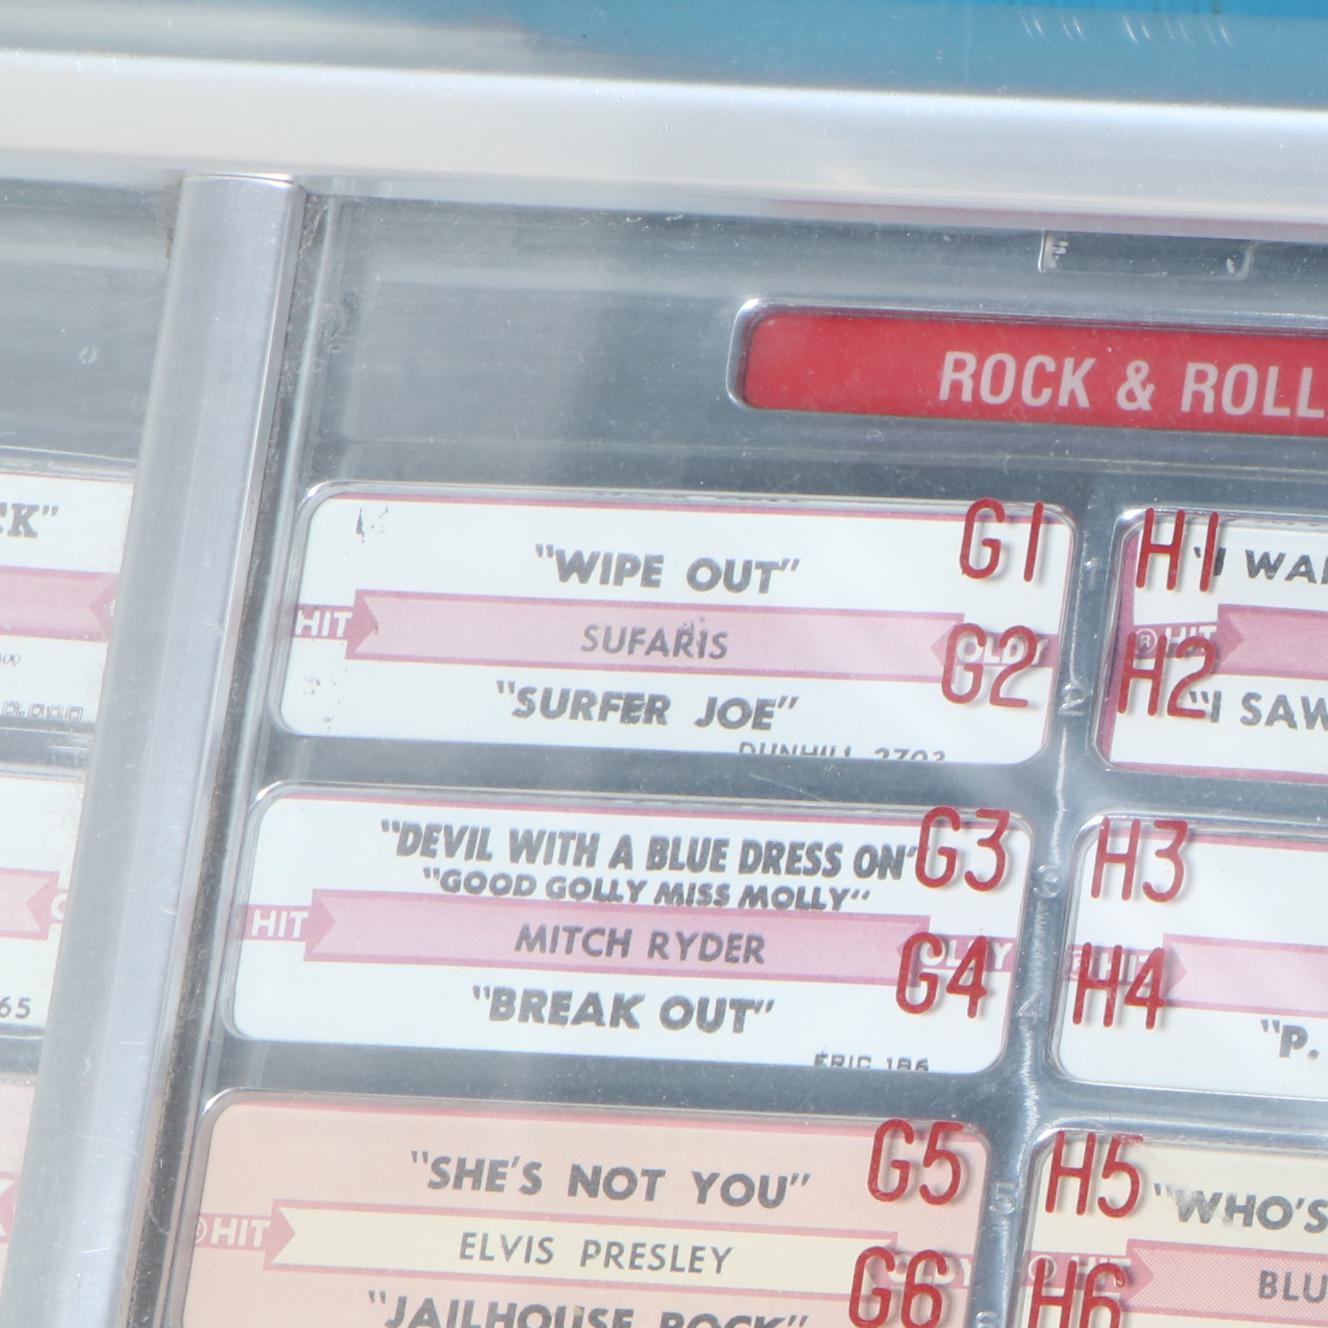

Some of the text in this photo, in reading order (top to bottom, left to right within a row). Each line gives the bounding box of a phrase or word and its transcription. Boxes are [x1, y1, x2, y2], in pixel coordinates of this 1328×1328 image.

[938, 350, 1326, 418] ROCK & ROLL
[959, 497, 1046, 582] G1
[535, 544, 800, 594] "WIPE OUT"
[581, 623, 728, 660] SUFARIS
[1114, 632, 1216, 718] H2
[496, 680, 798, 732] "SURFER JOE"
[916, 806, 1010, 892] G3
[1092, 818, 1188, 902] H3
[514, 924, 766, 964] MITCH RYDER
[472, 986, 775, 1034] "BREAK OUT"
[410, 1150, 810, 1208] "SHE'S NOT YOU"
[868, 1118, 964, 1206] G5
[458, 1232, 733, 1274] ELVIS PRESLEY
